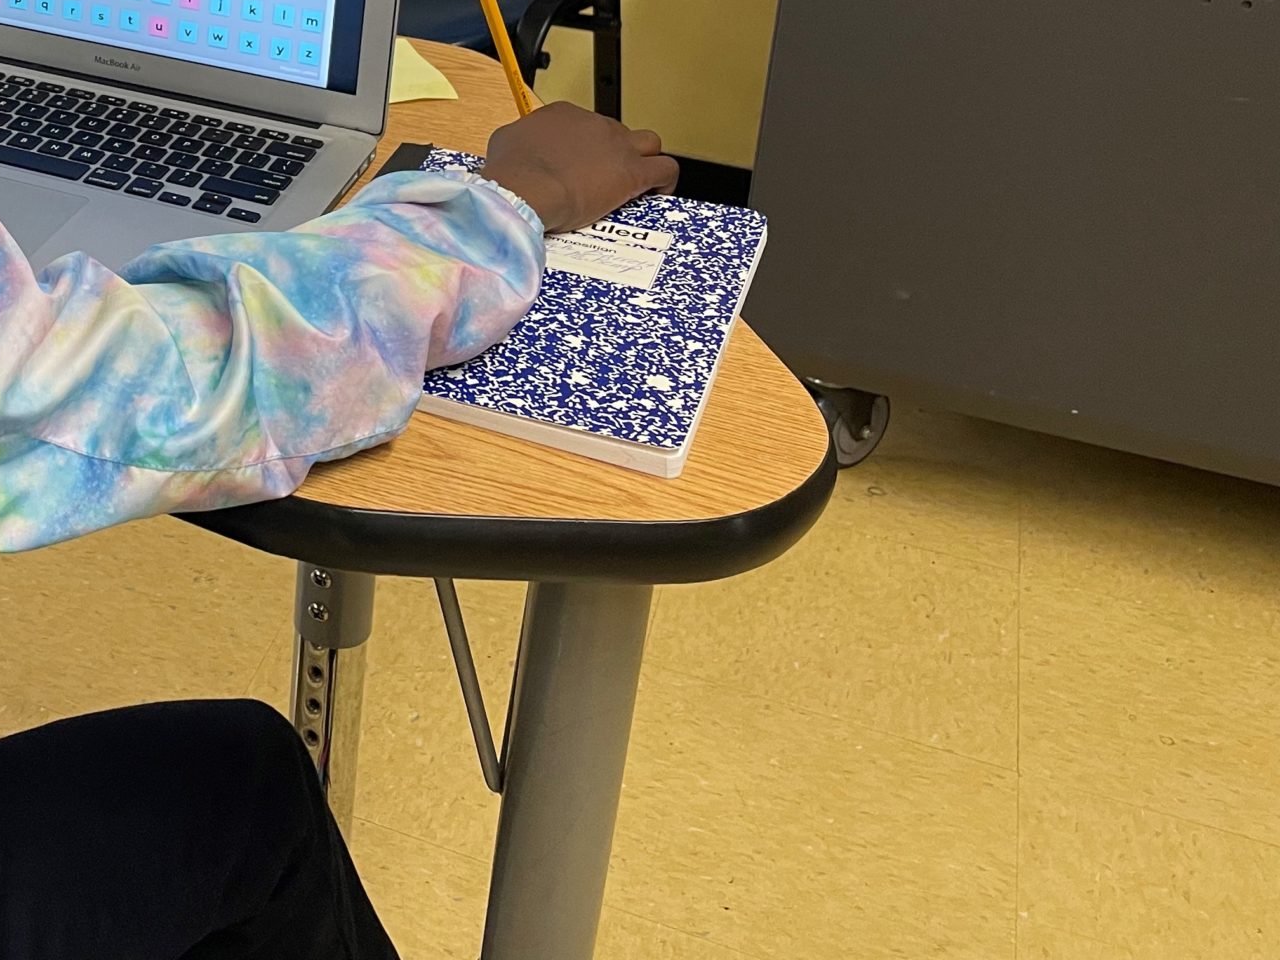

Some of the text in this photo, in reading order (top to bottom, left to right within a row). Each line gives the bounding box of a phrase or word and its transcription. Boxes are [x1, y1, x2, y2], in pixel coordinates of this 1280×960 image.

[94, 55, 142, 71] MacBook Air
[591, 223, 649, 241] uled
[544, 234, 617, 254] omposition
